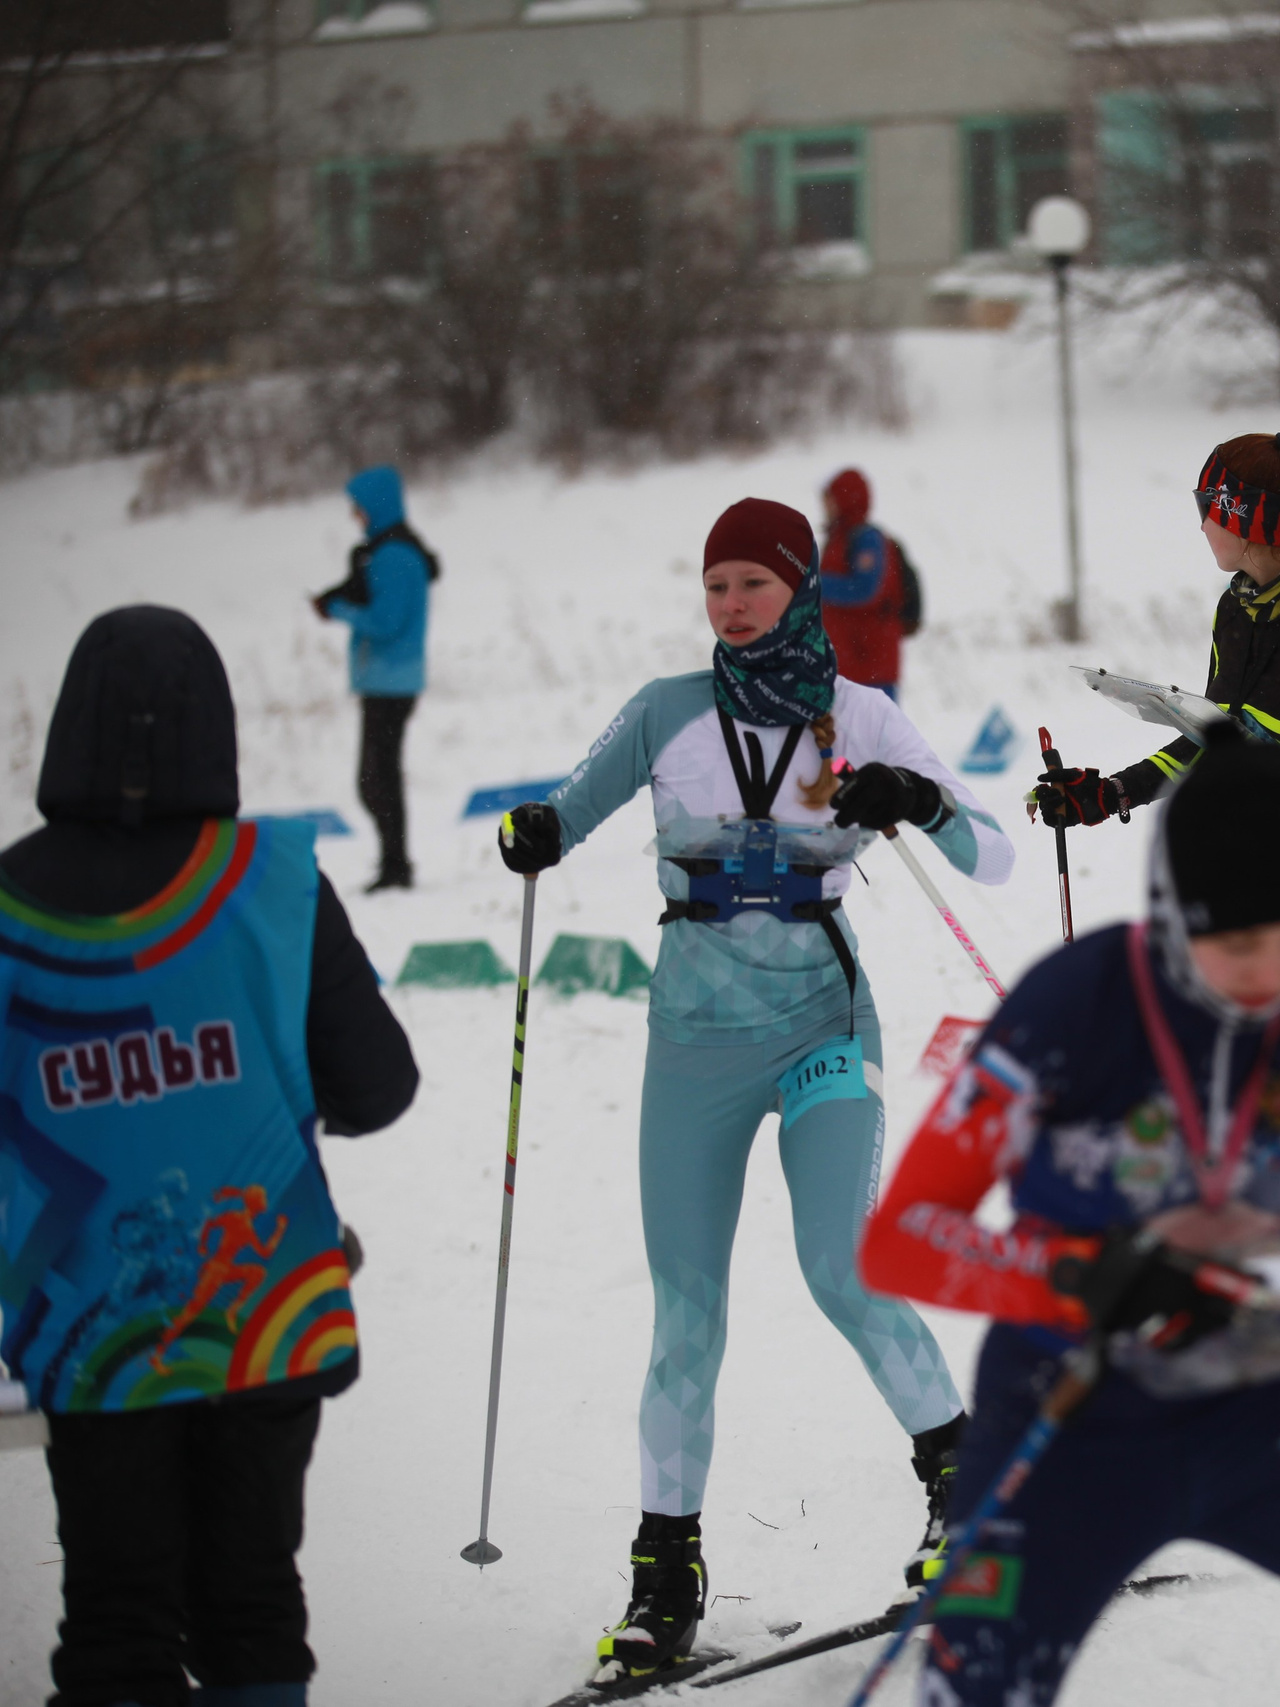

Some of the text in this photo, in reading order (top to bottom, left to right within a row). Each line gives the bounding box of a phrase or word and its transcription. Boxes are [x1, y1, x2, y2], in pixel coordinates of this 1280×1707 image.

[754, 678, 784, 706] NEW
[38, 1019, 242, 1113] СУДЬЯ
[796, 1055, 849, 1091] 110.2
[865, 1106, 886, 1218] NORDSKI
